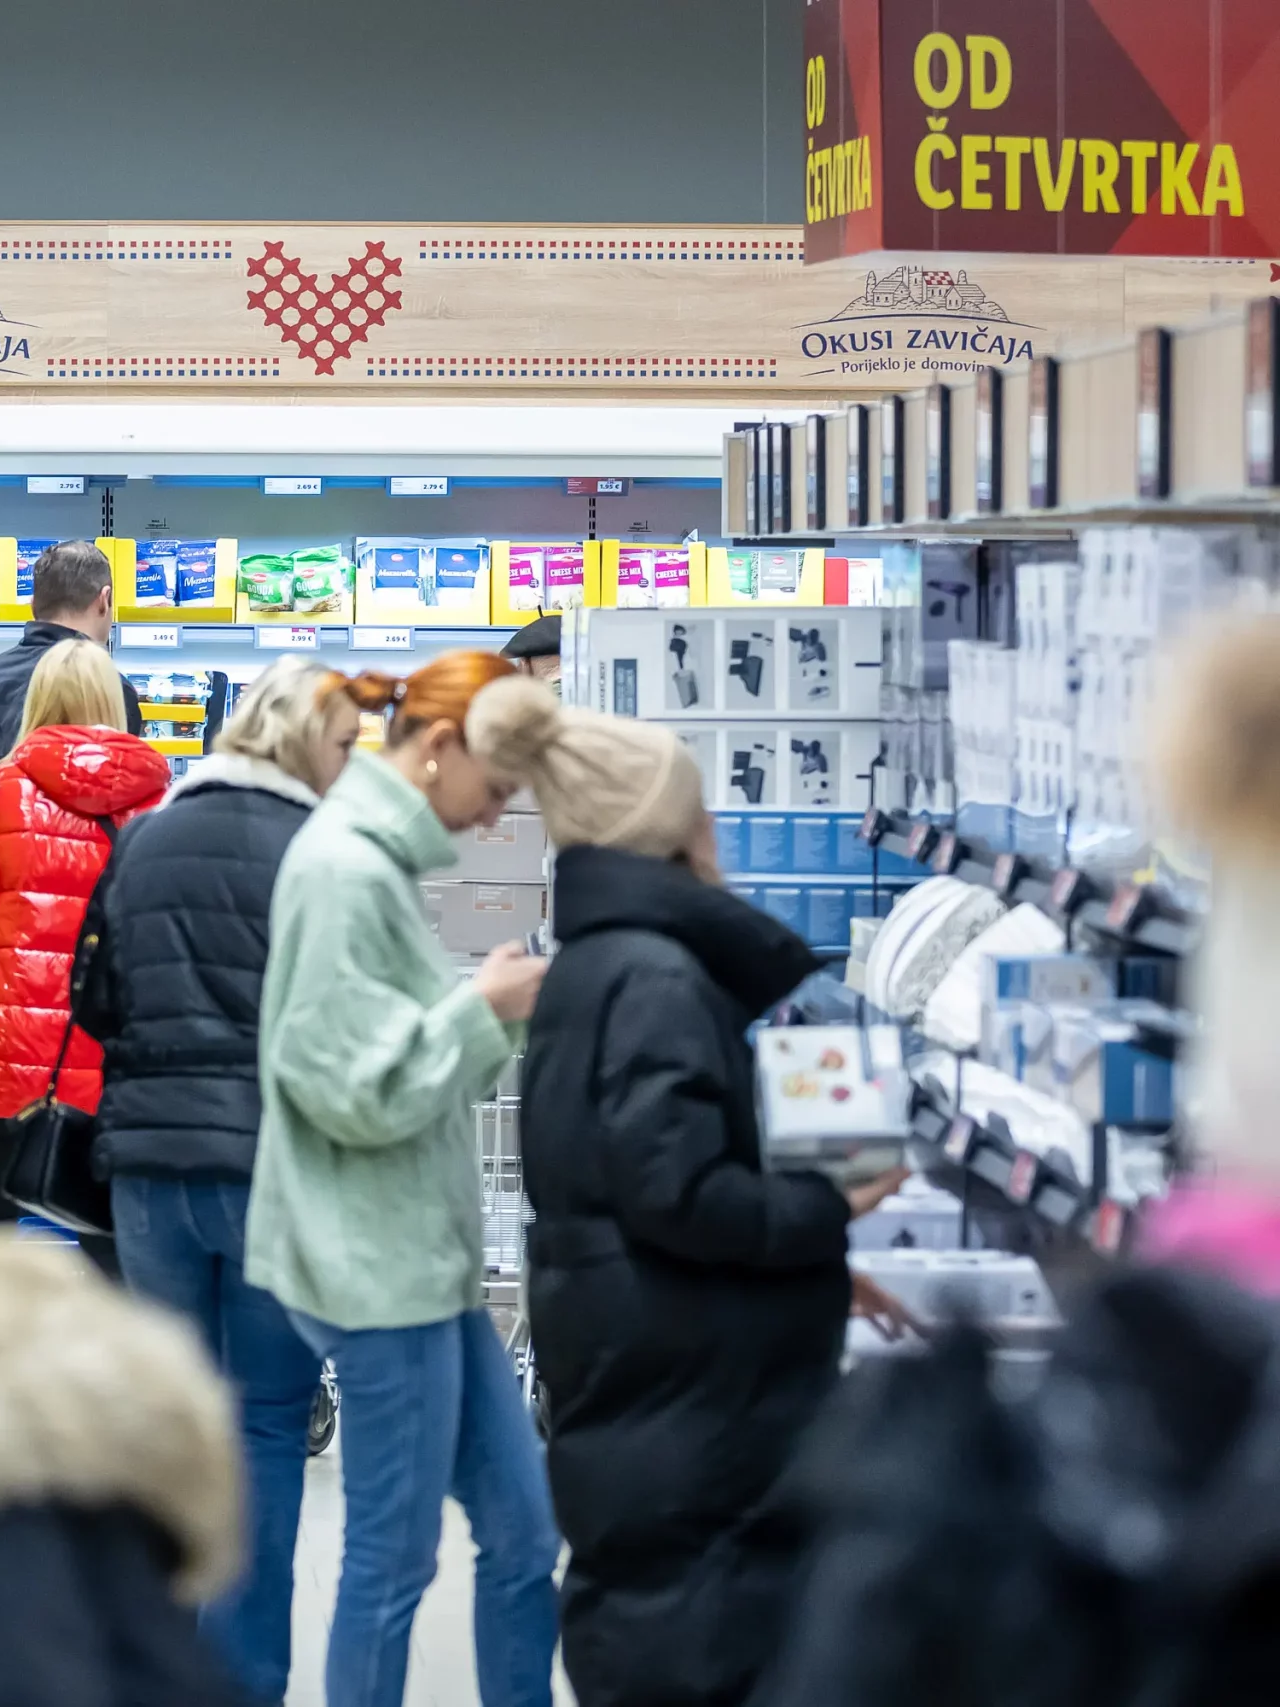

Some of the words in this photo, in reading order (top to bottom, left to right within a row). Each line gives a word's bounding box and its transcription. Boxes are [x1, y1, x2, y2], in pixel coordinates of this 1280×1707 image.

[914, 32, 1013, 110] OD
[805, 55, 826, 129] OD
[805, 135, 872, 224] ČETVRTKA
[914, 116, 1245, 217] ČETVRTKA
[801, 329, 893, 359] OKUSI
[906, 325, 1034, 364] ZAVIČAJA
[841, 358, 900, 374] Porijeklo
[904, 358, 916, 375] je
[921, 357, 992, 373] domovin
[247, 583, 274, 596] GOUDA
[550, 567, 572, 577] CHEESE
[656, 570, 678, 579] CHEESE
